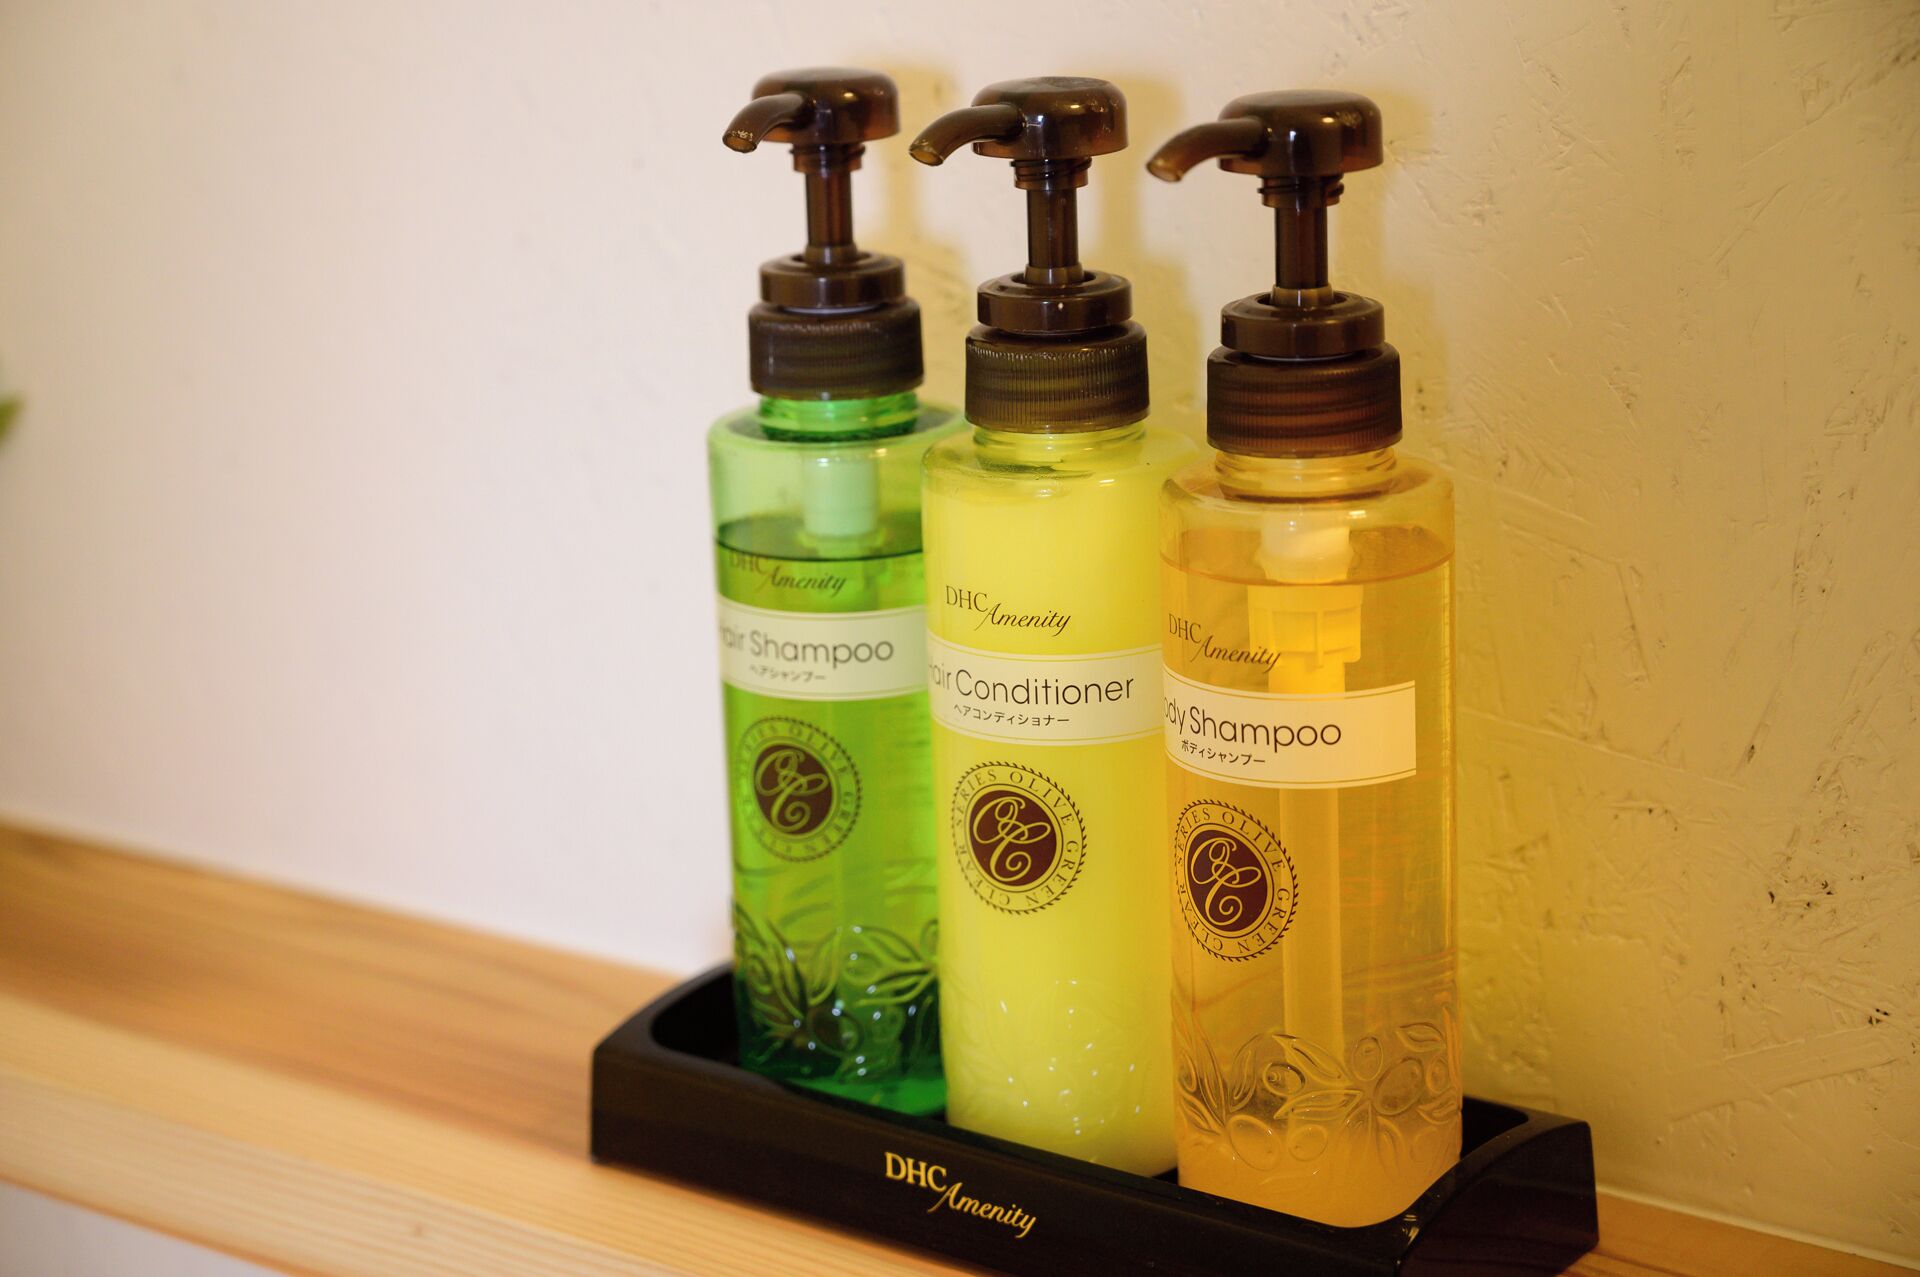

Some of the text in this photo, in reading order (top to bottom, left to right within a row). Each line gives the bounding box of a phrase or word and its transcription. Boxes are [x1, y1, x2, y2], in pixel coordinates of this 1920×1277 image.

[754, 564, 847, 599] Amenity
[945, 585, 1071, 637] DHC Amenity
[750, 629, 894, 669] Shampoo
[1168, 613, 1282, 674] DHC Amenity
[749, 664, 827, 683] ヘアシャンプー
[956, 669, 1134, 706] Conditioner
[953, 703, 1070, 727] ヘアコンディショナー
[1190, 705, 1342, 753] Shampoo
[1181, 739, 1266, 766] ボディシャンプー
[1009, 770, 1074, 826] OLIVE
[1221, 811, 1286, 872] OLIVE
[1025, 840, 1080, 907] GREEN
[1237, 888, 1290, 953] GREEN
[884, 1151, 1037, 1238] DHC Amenity
